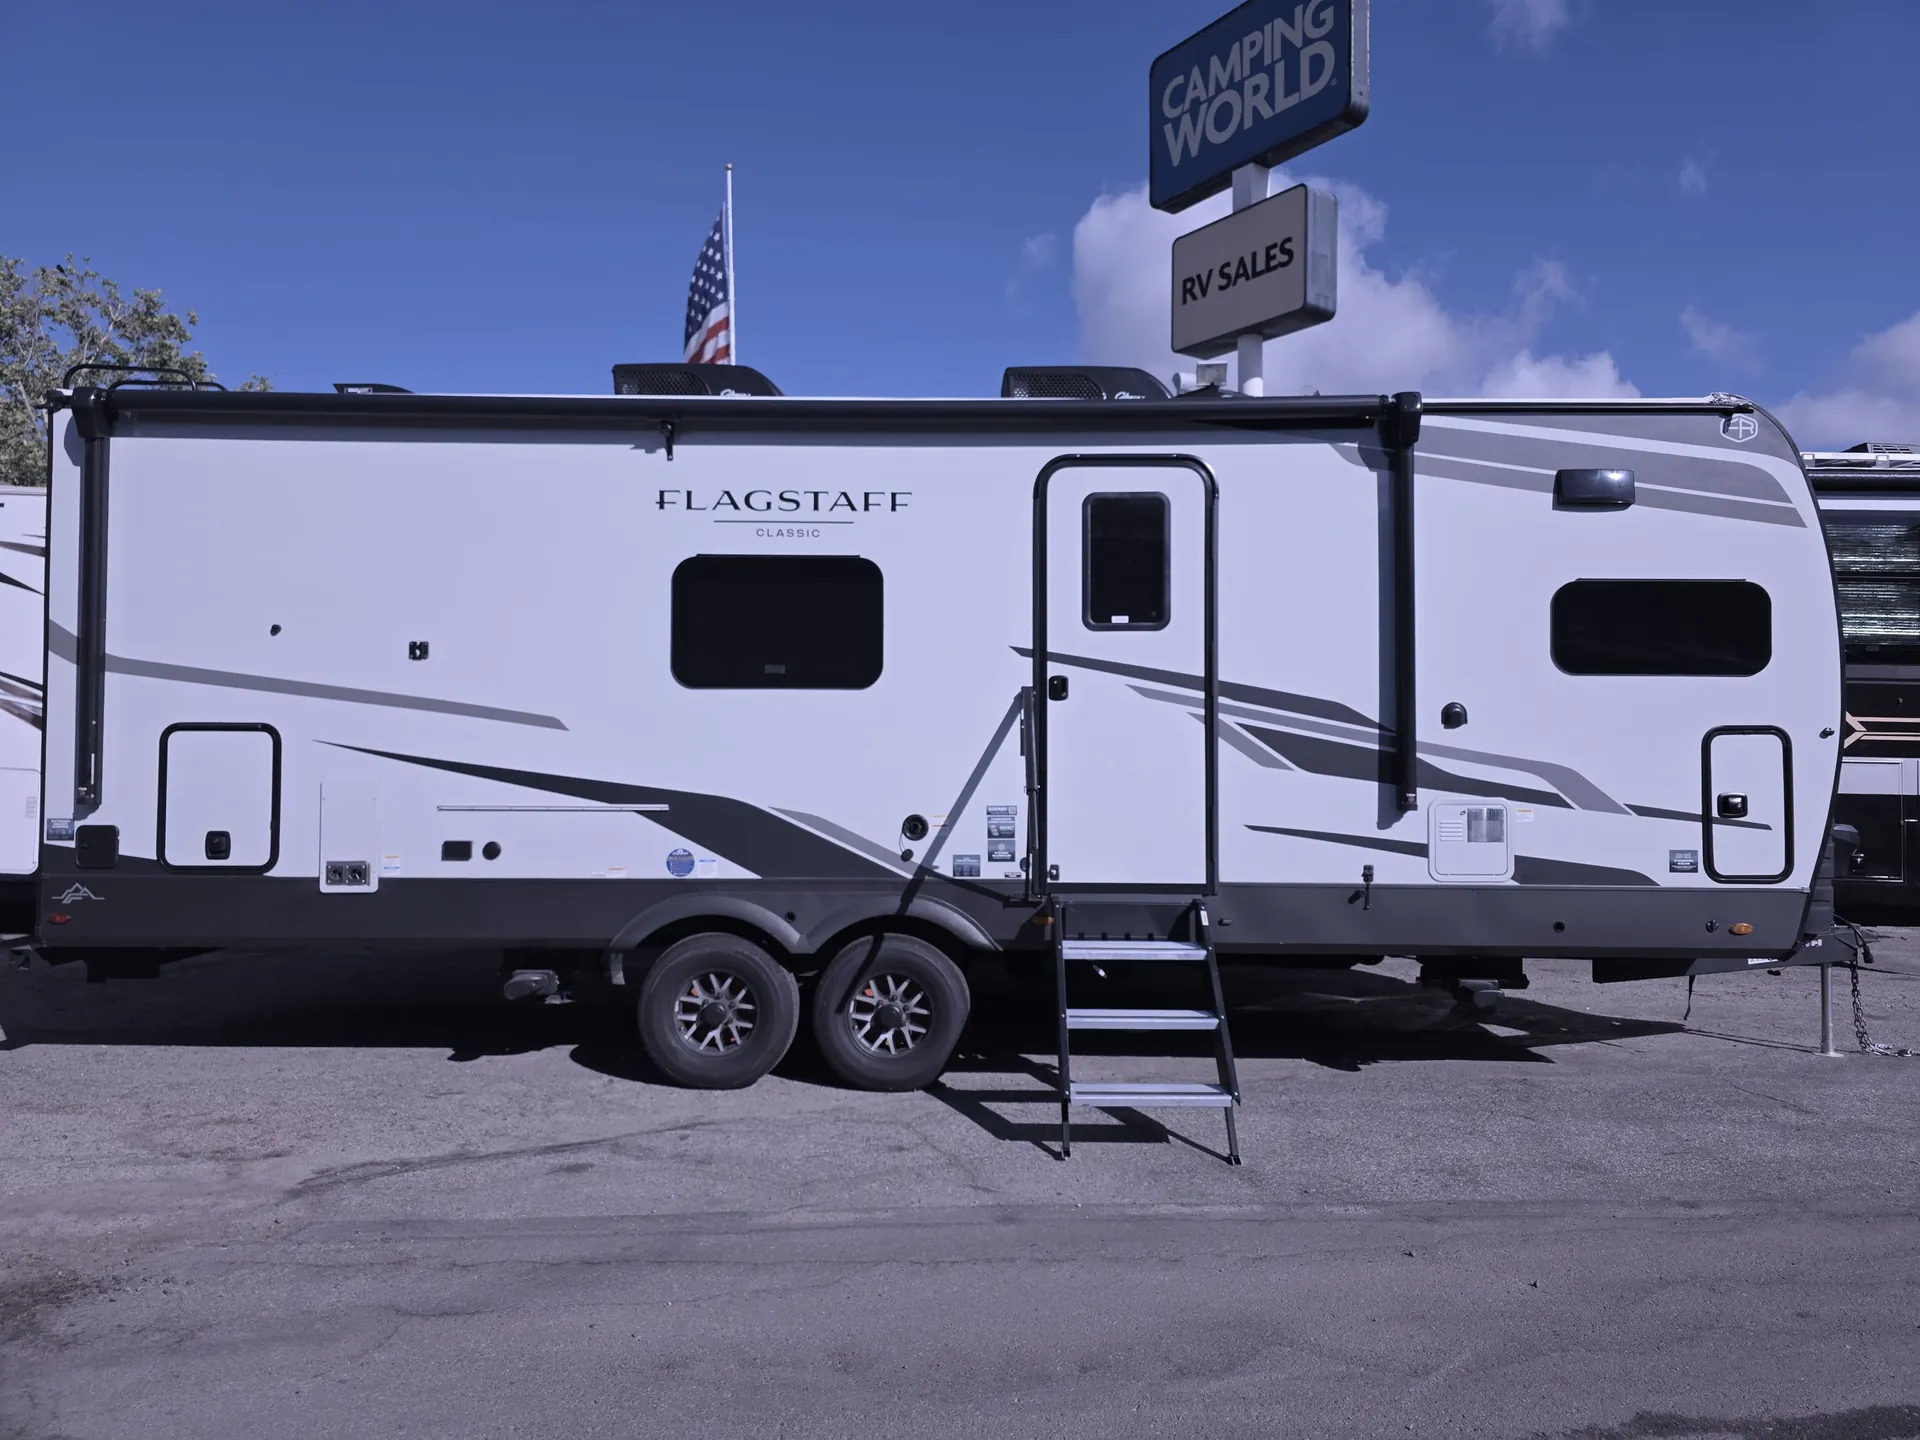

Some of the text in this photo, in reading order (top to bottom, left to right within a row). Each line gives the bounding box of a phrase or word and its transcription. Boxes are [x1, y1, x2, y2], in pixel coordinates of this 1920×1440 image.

[1162, 0, 1334, 119] CAMPING
[1163, 40, 1336, 168] WORLD
[1181, 236, 1295, 306] RV SALES
[655, 489, 913, 513] FLAGSTAFF
[755, 528, 821, 539] CLASSIC
